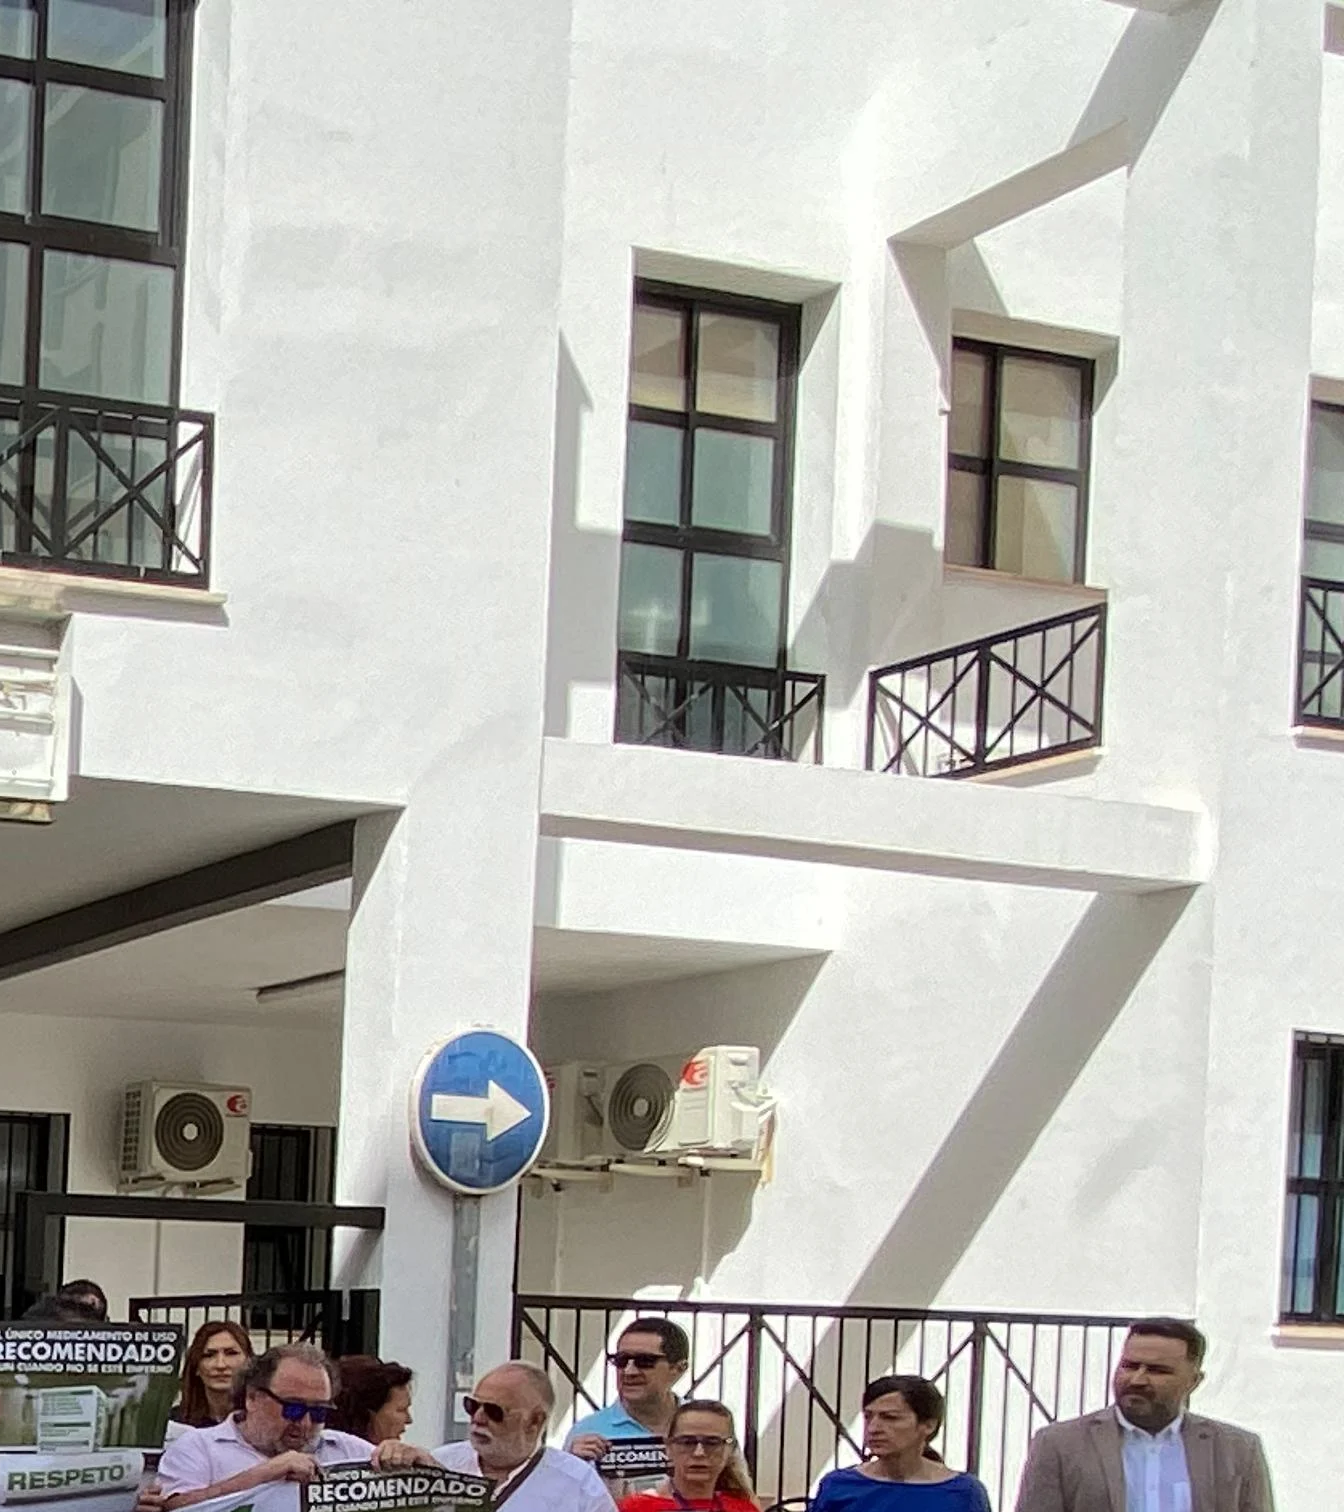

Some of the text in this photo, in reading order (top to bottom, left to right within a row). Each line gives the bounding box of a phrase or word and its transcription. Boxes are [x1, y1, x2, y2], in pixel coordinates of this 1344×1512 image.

[46, 1330, 132, 1342] MEDICAMENTO
[135, 1331, 149, 1342] DE
[152, 1332, 177, 1343] USO
[7, 1465, 124, 1491] RESPETO
[307, 1477, 487, 1503] RECOMENDADO
